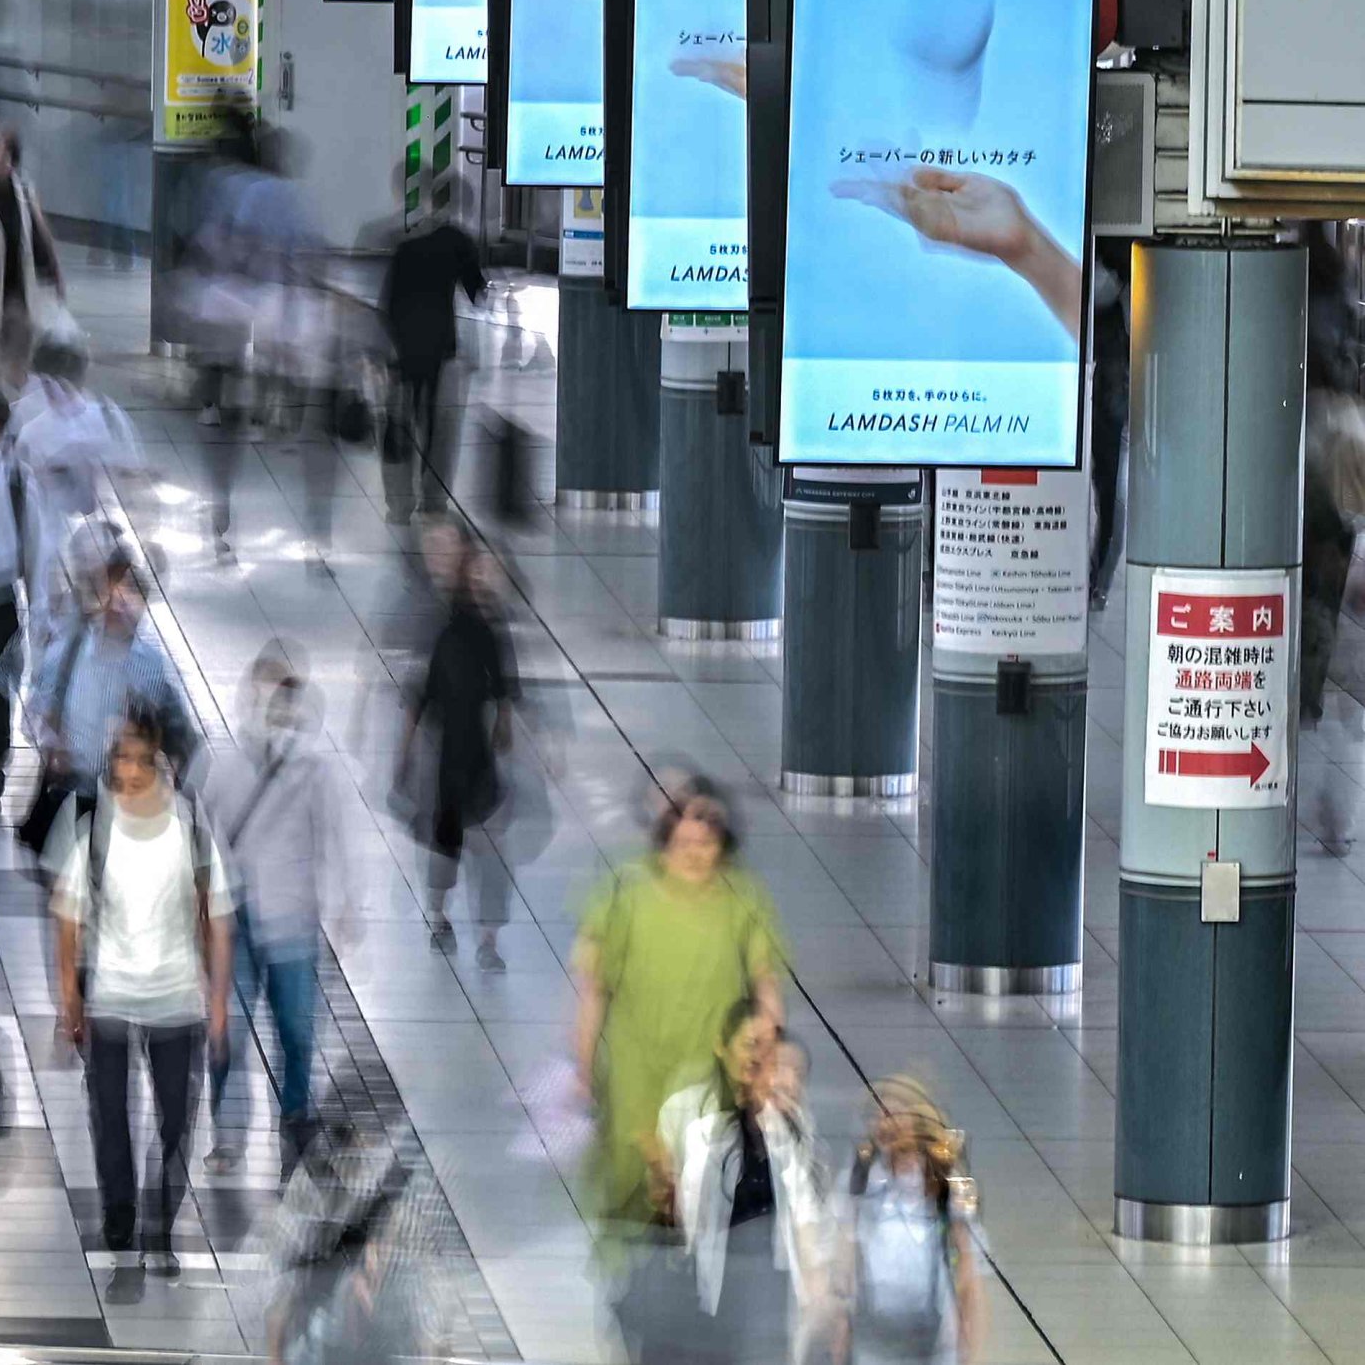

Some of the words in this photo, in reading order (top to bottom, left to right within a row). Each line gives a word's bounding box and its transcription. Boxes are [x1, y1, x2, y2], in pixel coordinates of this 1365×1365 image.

[445, 46, 486, 60] LAM
[840, 148, 1037, 165] シェーバーの新しいカタチ
[872, 388, 988, 403] 5枚刃を、手のひらに。
[828, 412, 937, 433] LAMDASH
[943, 414, 1002, 433] PALM
[1007, 415, 1030, 433] IN
[1171, 603, 1271, 633] ご案内
[1167, 643, 1274, 665] 朝の混雑時は
[1175, 669, 1265, 691] 通路両端を
[1168, 697, 1271, 719] ご通行下さい
[1157, 723, 1272, 741] ご協力お願いします
